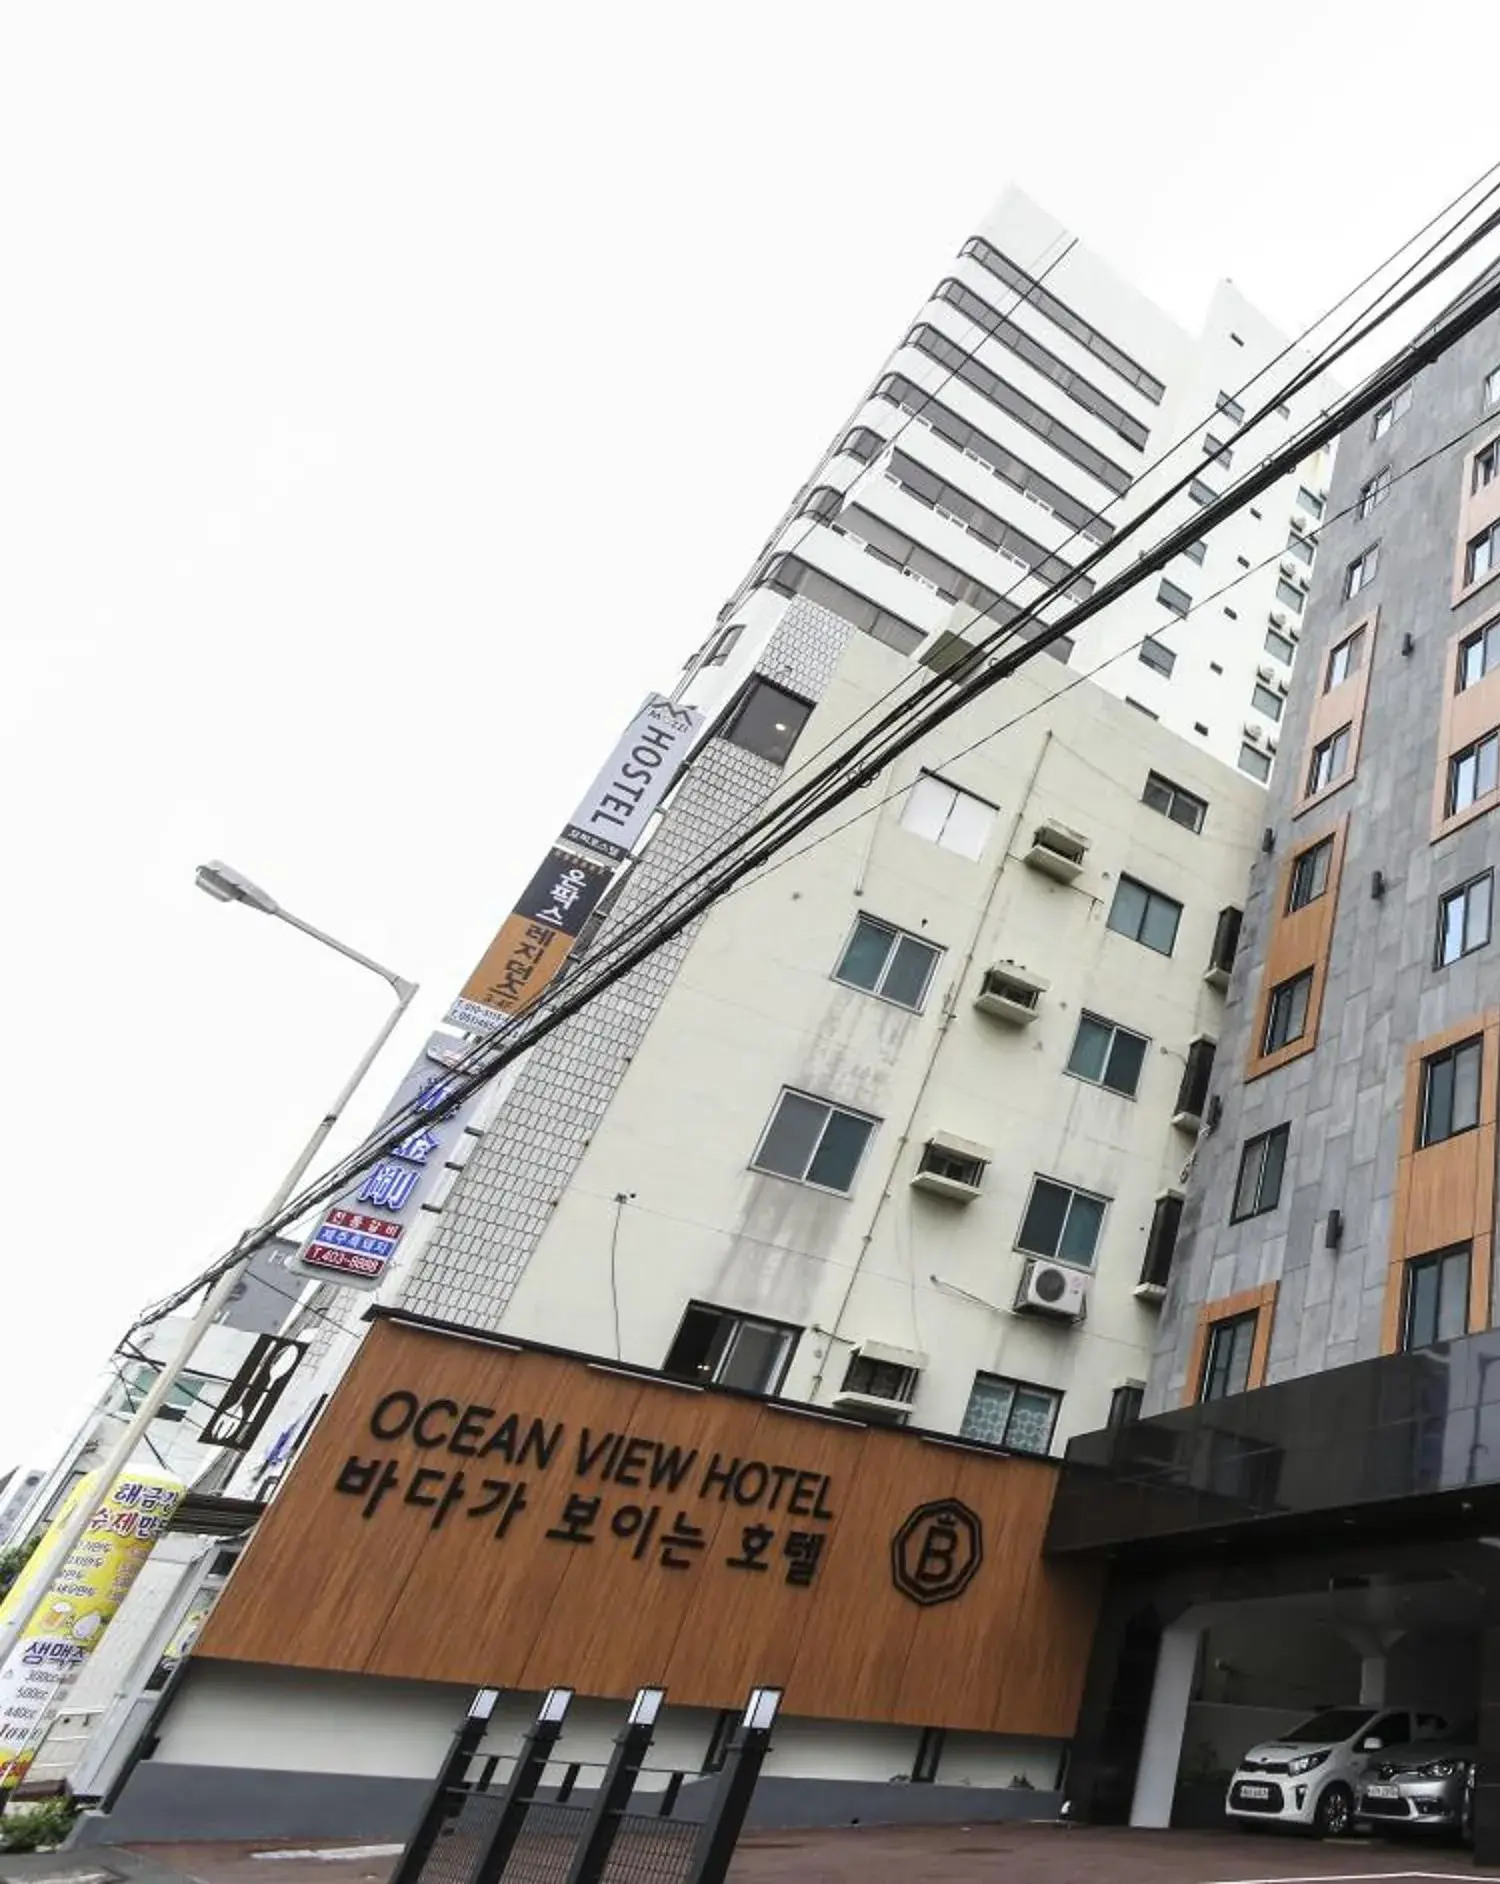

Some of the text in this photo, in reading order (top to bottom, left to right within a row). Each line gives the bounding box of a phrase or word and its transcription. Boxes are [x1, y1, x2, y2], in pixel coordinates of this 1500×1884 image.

[591, 725, 675, 827] HOSTEL
[369, 1390, 834, 1520] OCEAN VIEW HOTEL
[334, 1456, 827, 1588] 바다가 보이는 호텔
[915, 1525, 958, 1582] B
